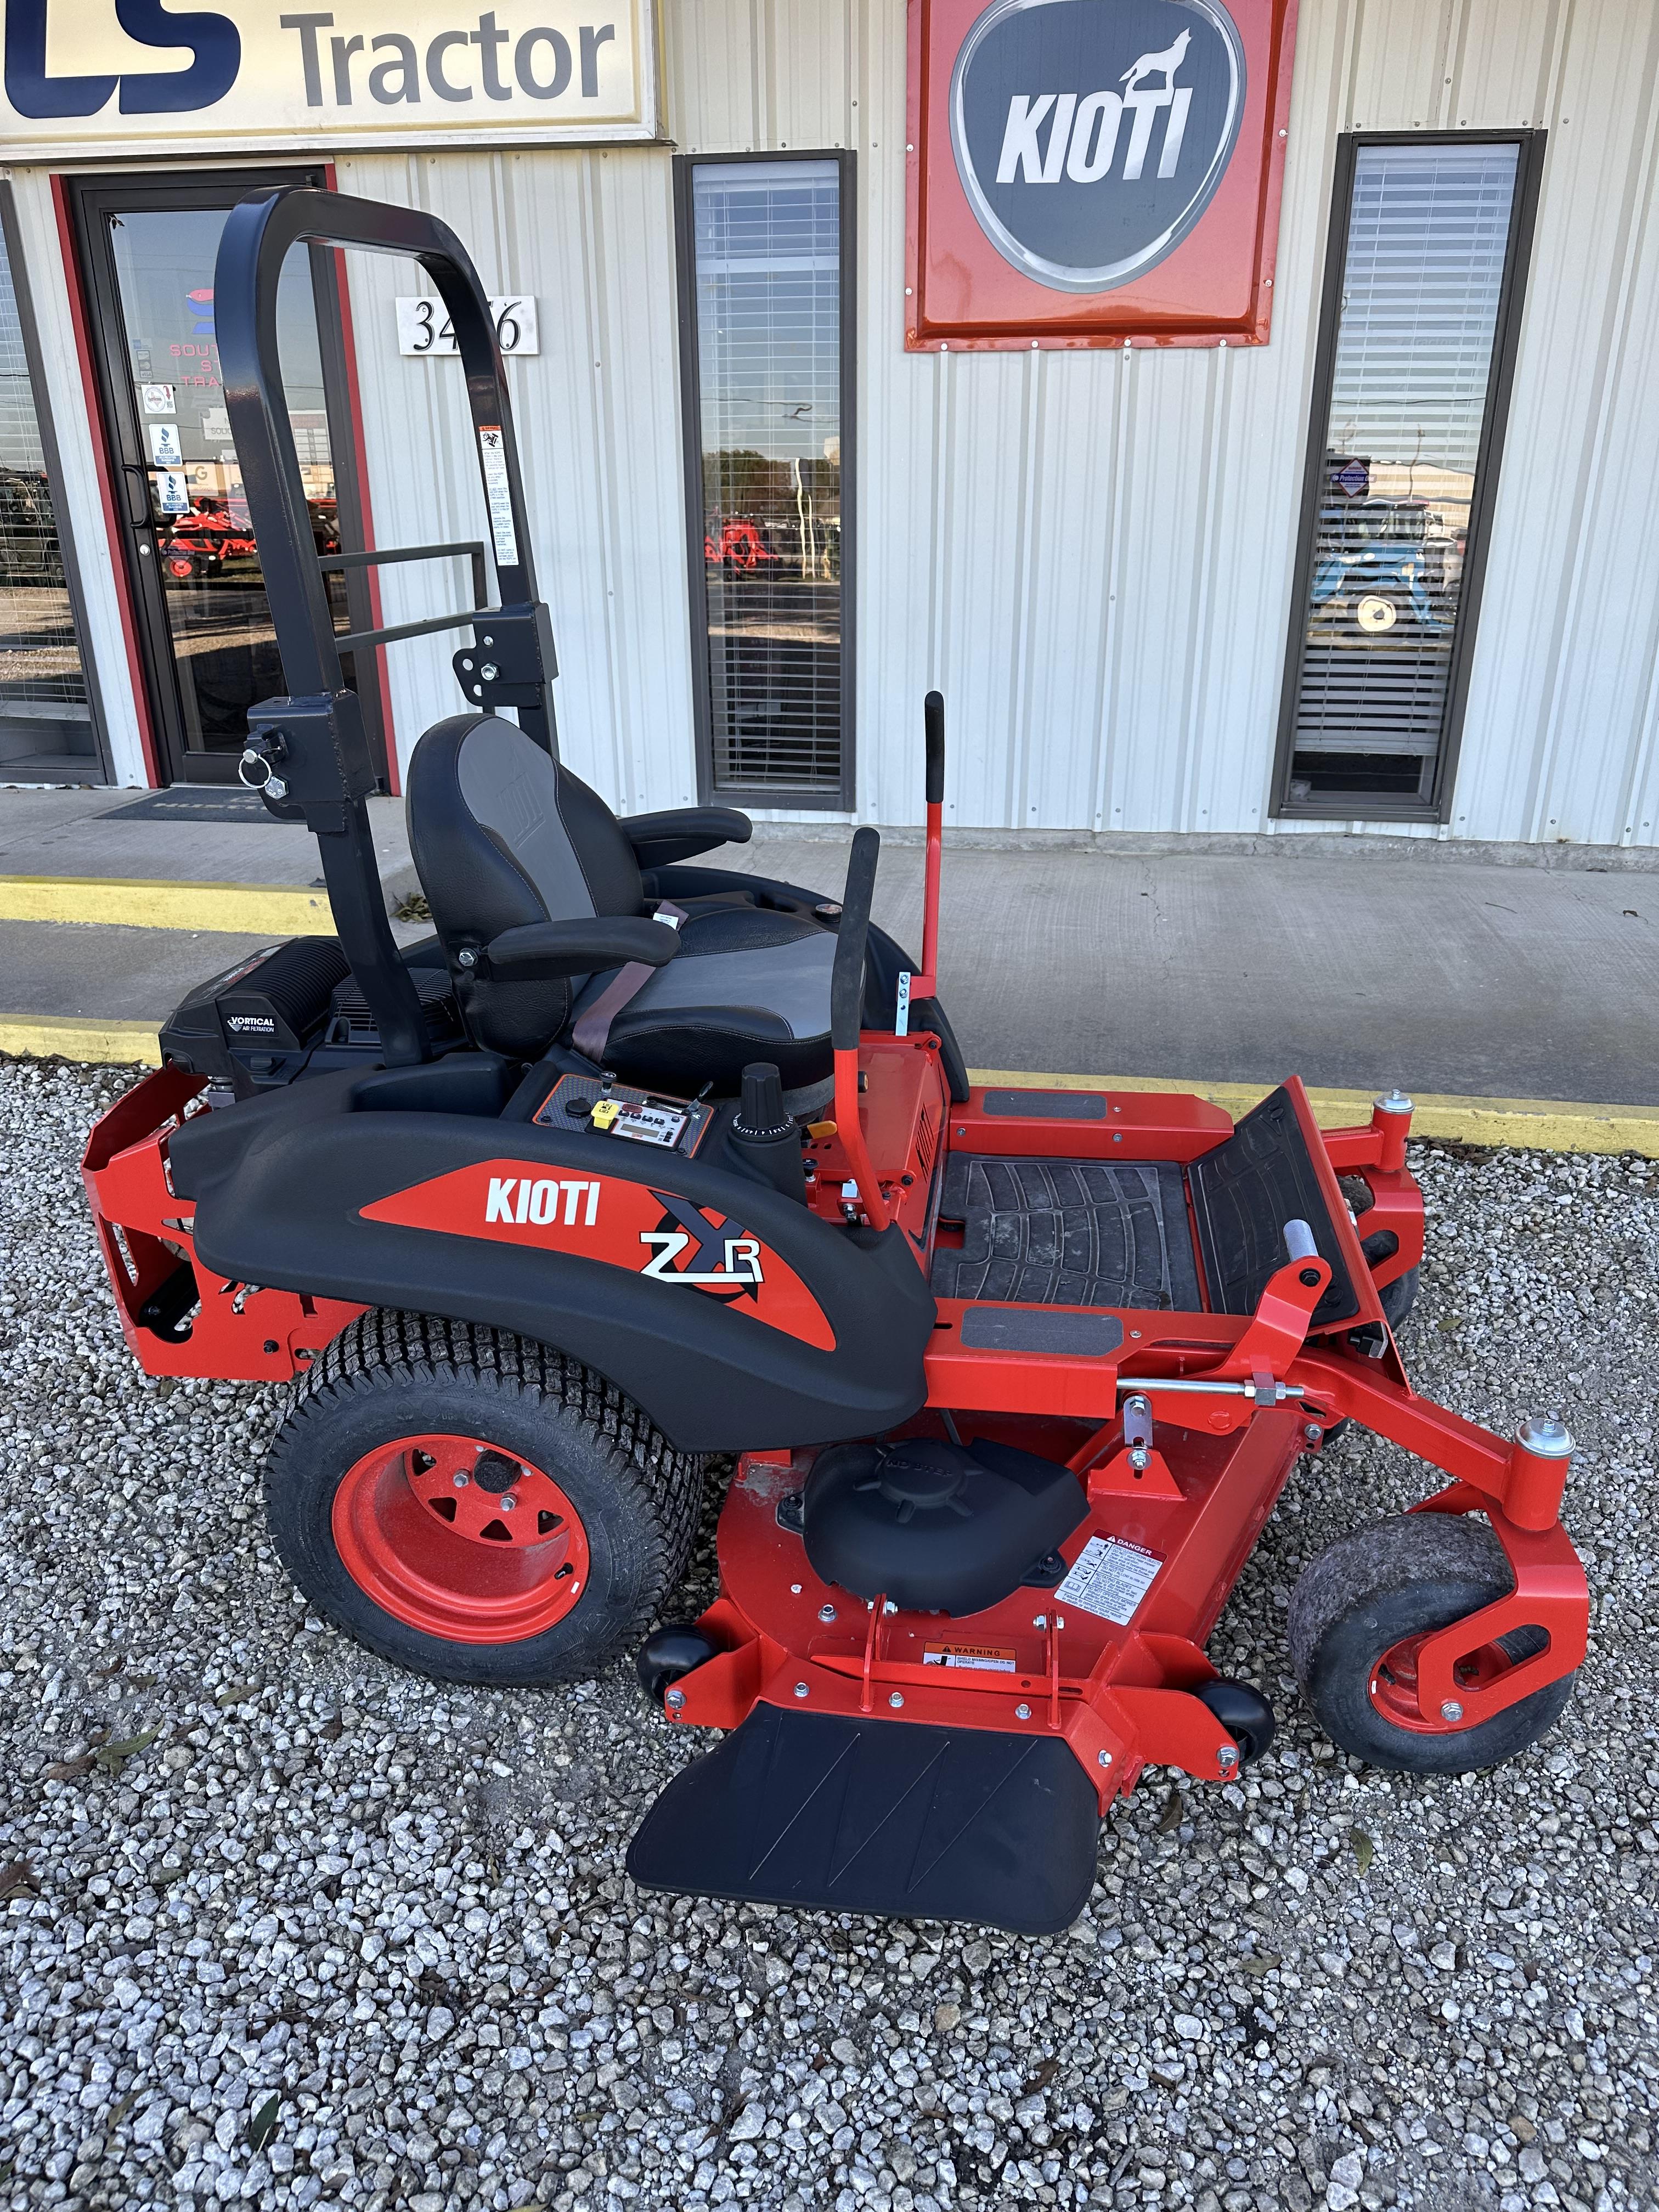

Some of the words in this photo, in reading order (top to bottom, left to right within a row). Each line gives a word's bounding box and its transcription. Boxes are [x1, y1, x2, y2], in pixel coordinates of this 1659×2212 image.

[4, 0, 241, 119] LS
[280, 11, 614, 107] Tractor
[996, 88, 1193, 184] KIOTI
[413, 301, 521, 351] 346
[232, 1017, 274, 1026] VORTICAL
[485, 1178, 601, 1226] KIOTI
[1117, 1539, 1152, 1554] DANGER
[955, 1647, 999, 1656] WARNING
